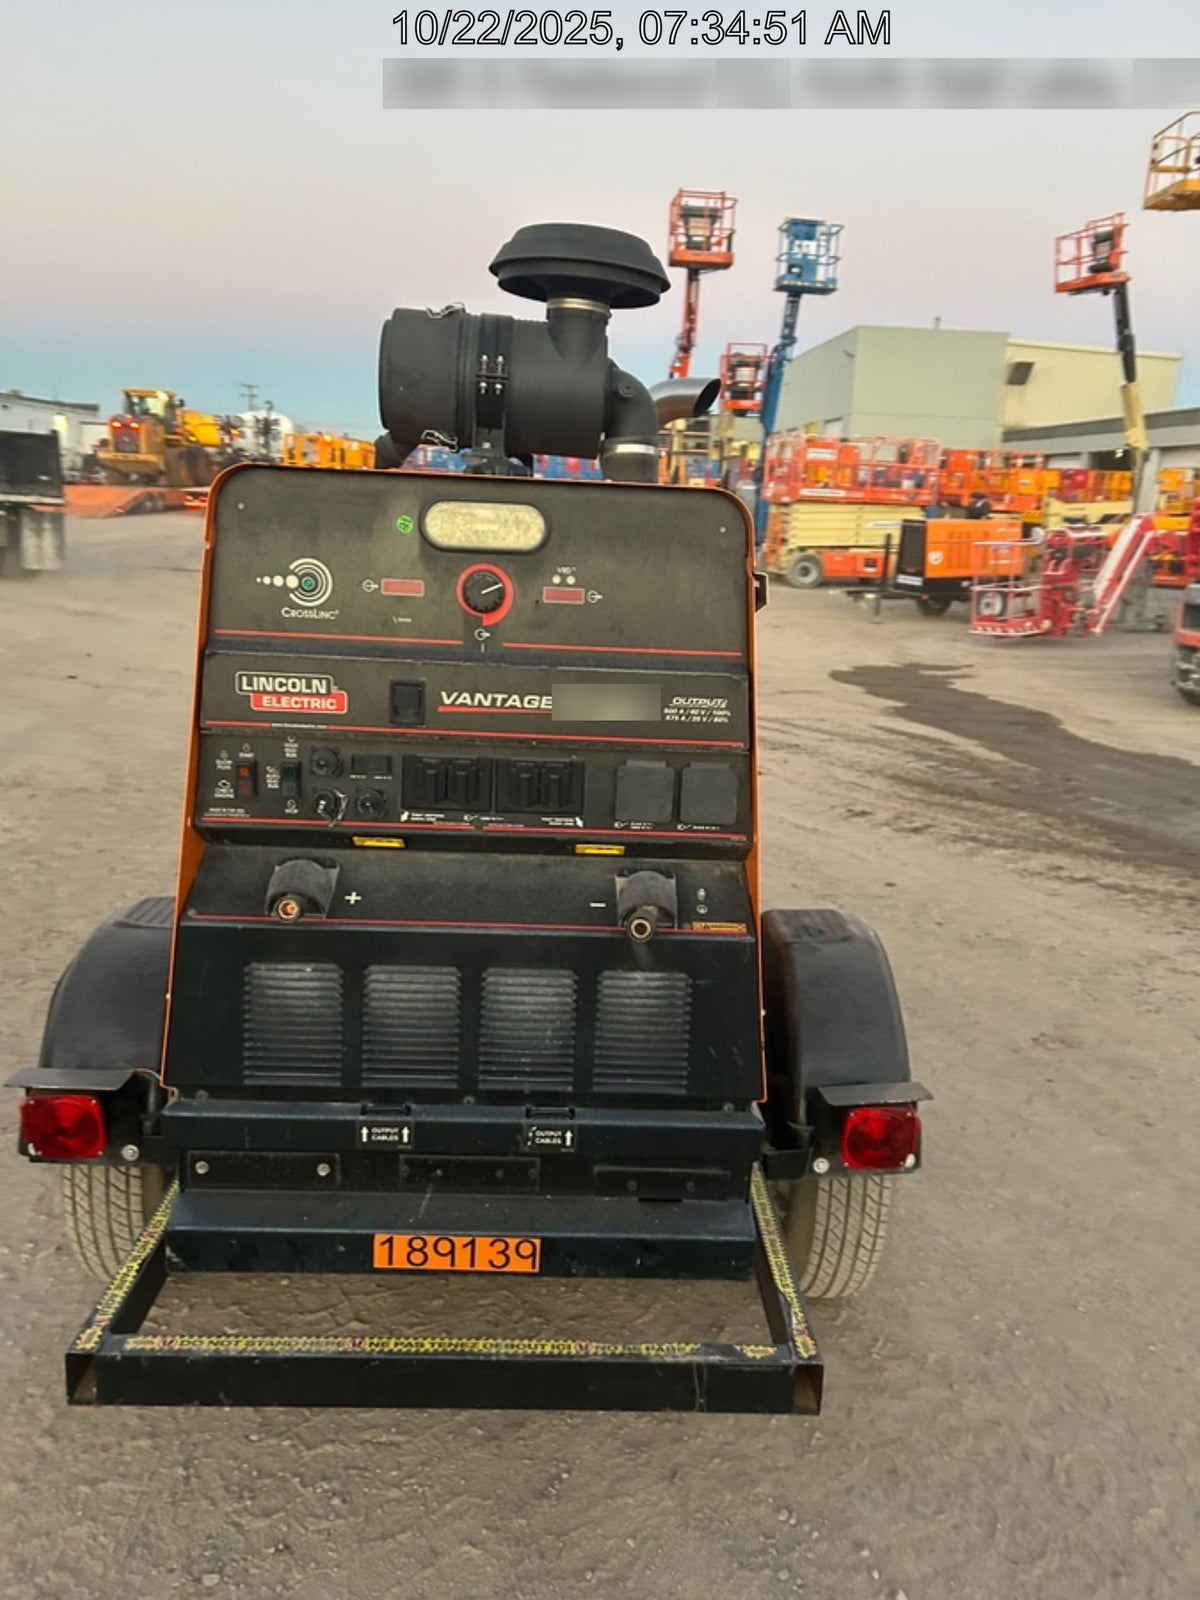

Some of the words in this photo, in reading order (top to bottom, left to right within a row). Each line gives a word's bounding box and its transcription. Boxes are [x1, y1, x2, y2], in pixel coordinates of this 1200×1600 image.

[242, 676, 327, 693] LINCOLN
[262, 695, 337, 710] ELECTRIC
[441, 691, 552, 709] VANTAGE
[672, 696, 725, 706] OUTPUT
[379, 1236, 538, 1270] 189139
[180, 1339, 203, 1347] DO
[207, 1339, 240, 1347] NOT
[394, 1341, 424, 1349] PAS
